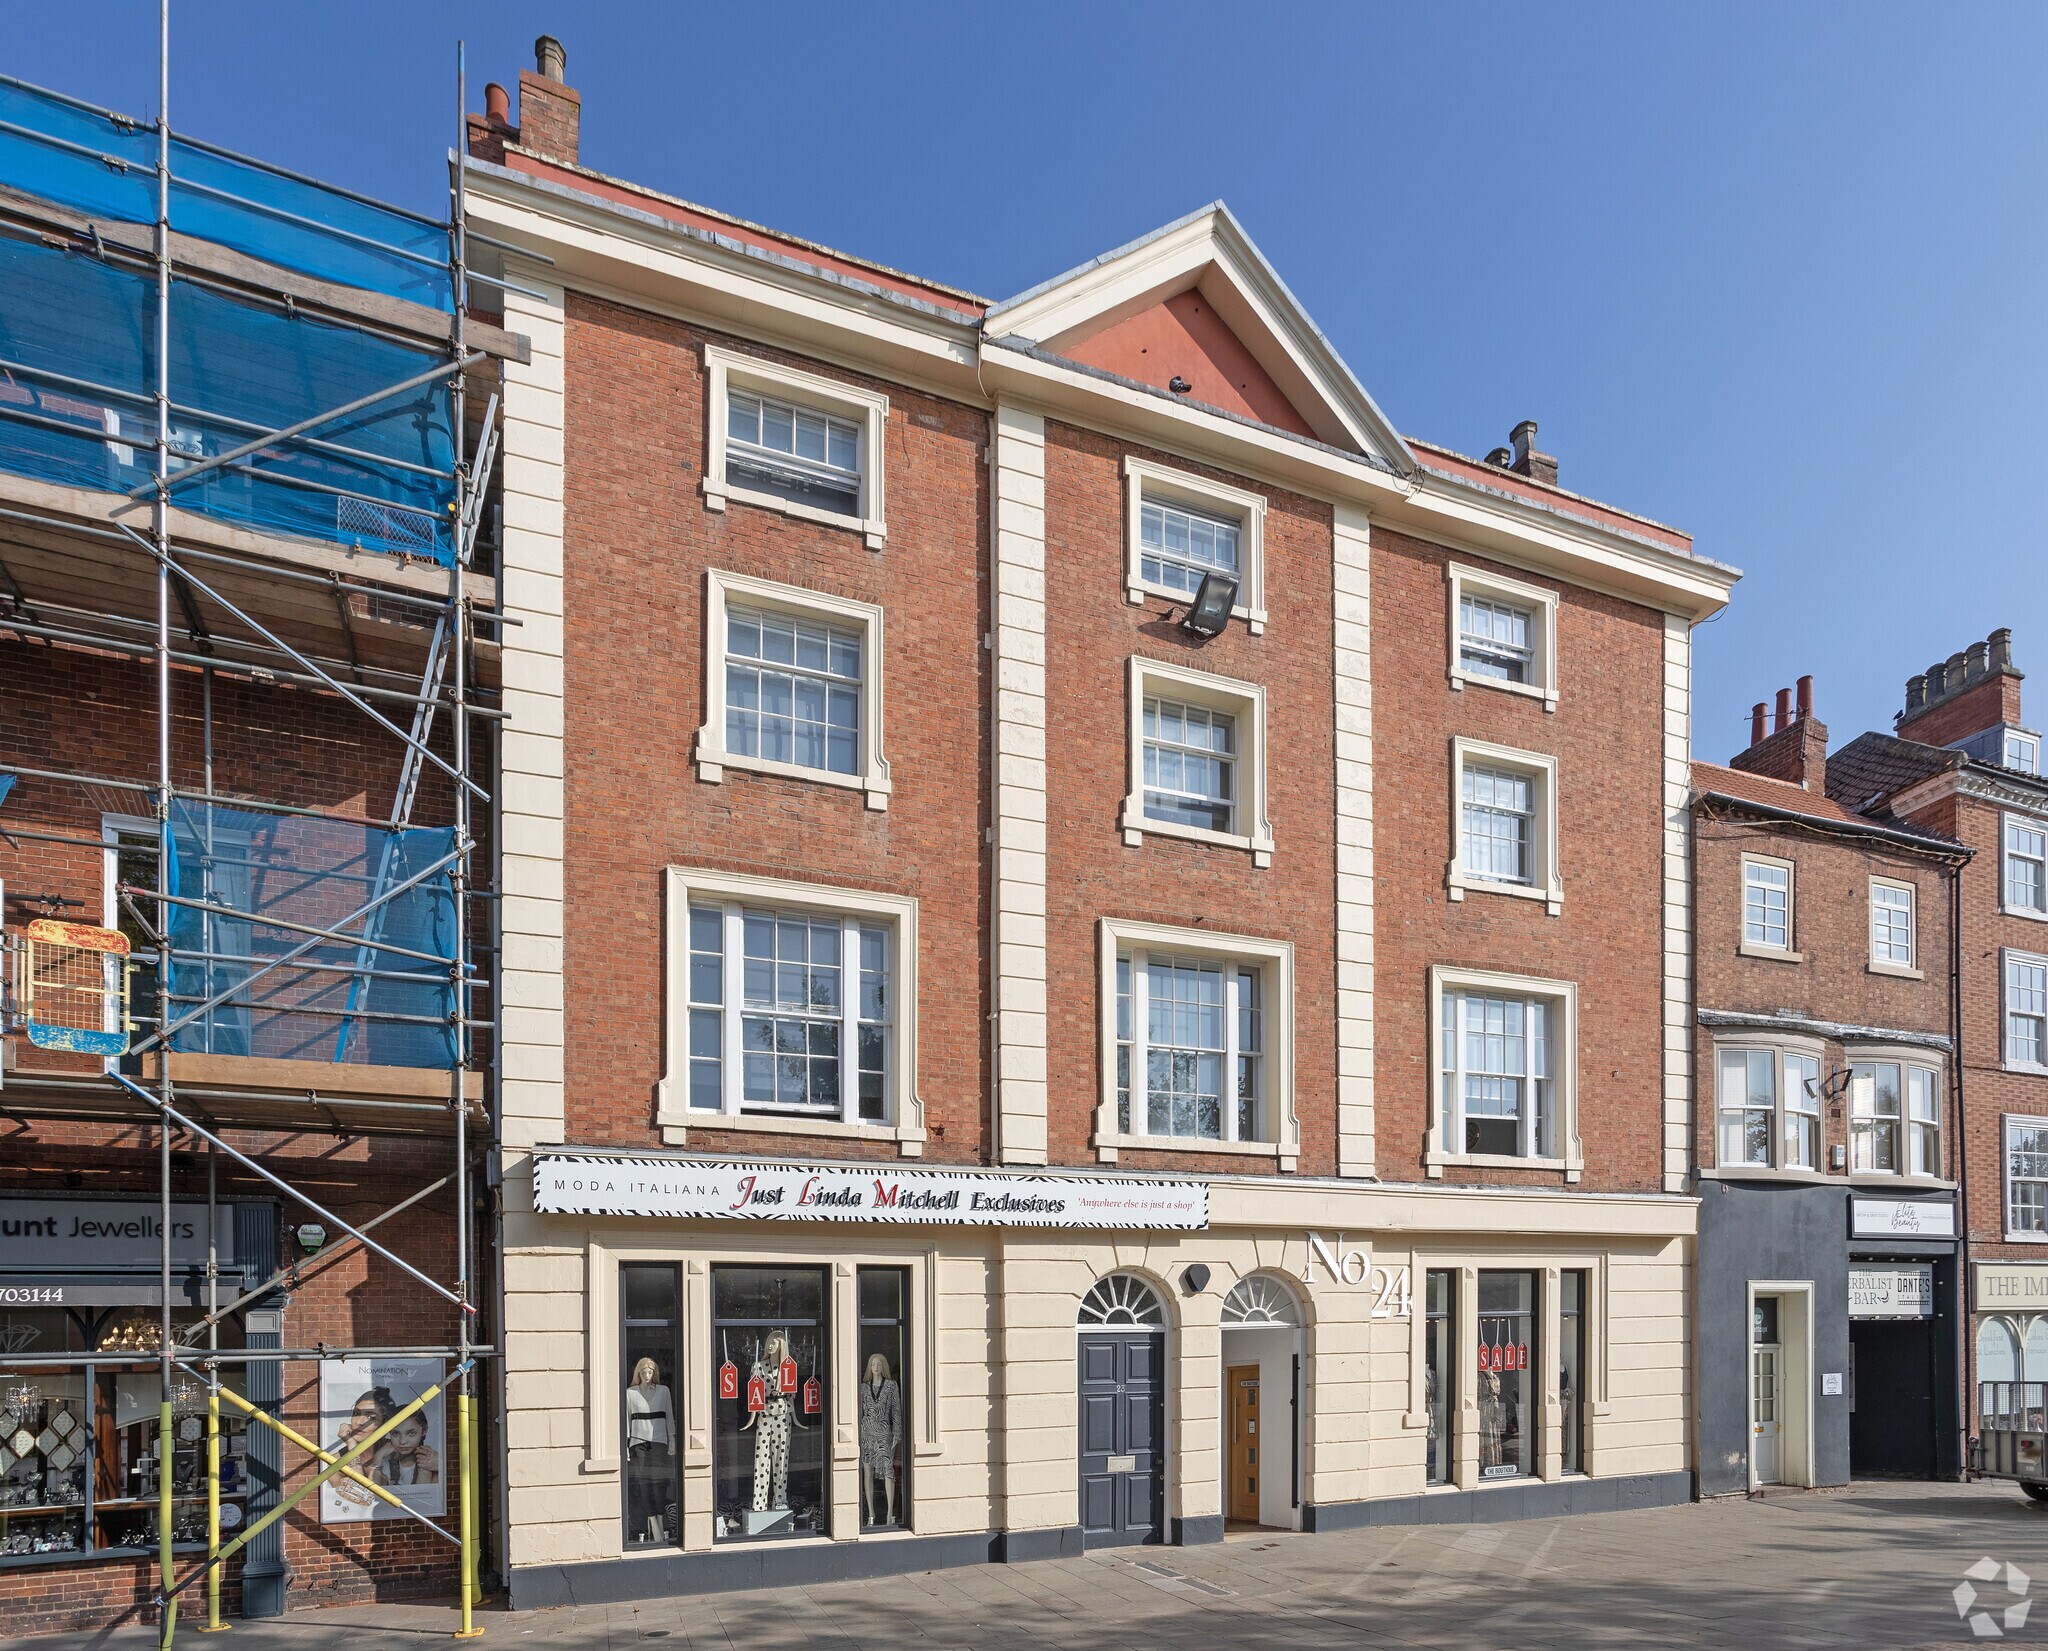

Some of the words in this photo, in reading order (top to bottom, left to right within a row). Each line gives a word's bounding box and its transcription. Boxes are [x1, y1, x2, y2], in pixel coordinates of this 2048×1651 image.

[554, 1180, 614, 1192] MODA
[630, 1183, 720, 1196] ITALIANA
[729, 1176, 786, 1212] Just
[797, 1177, 862, 1208] Linda
[871, 1179, 959, 1210] Mitchell
[970, 1191, 1065, 1213] Exclusives
[1124, 1199, 1139, 1208] else
[1141, 1200, 1148, 1208] is
[1149, 1200, 1165, 1212] just
[68, 1215, 194, 1239] Jewellers
[1305, 1230, 1370, 1285] No
[1372, 1265, 1413, 1319] 24
[1858, 1269, 1873, 1277] THE
[1897, 1278, 1930, 1293] DANTE'S
[1984, 1276, 2020, 1296] THE
[1854, 1292, 1878, 1305] BAR
[1480, 1350, 1527, 1367] SALE
[1116, 1384, 1125, 1393] 23
